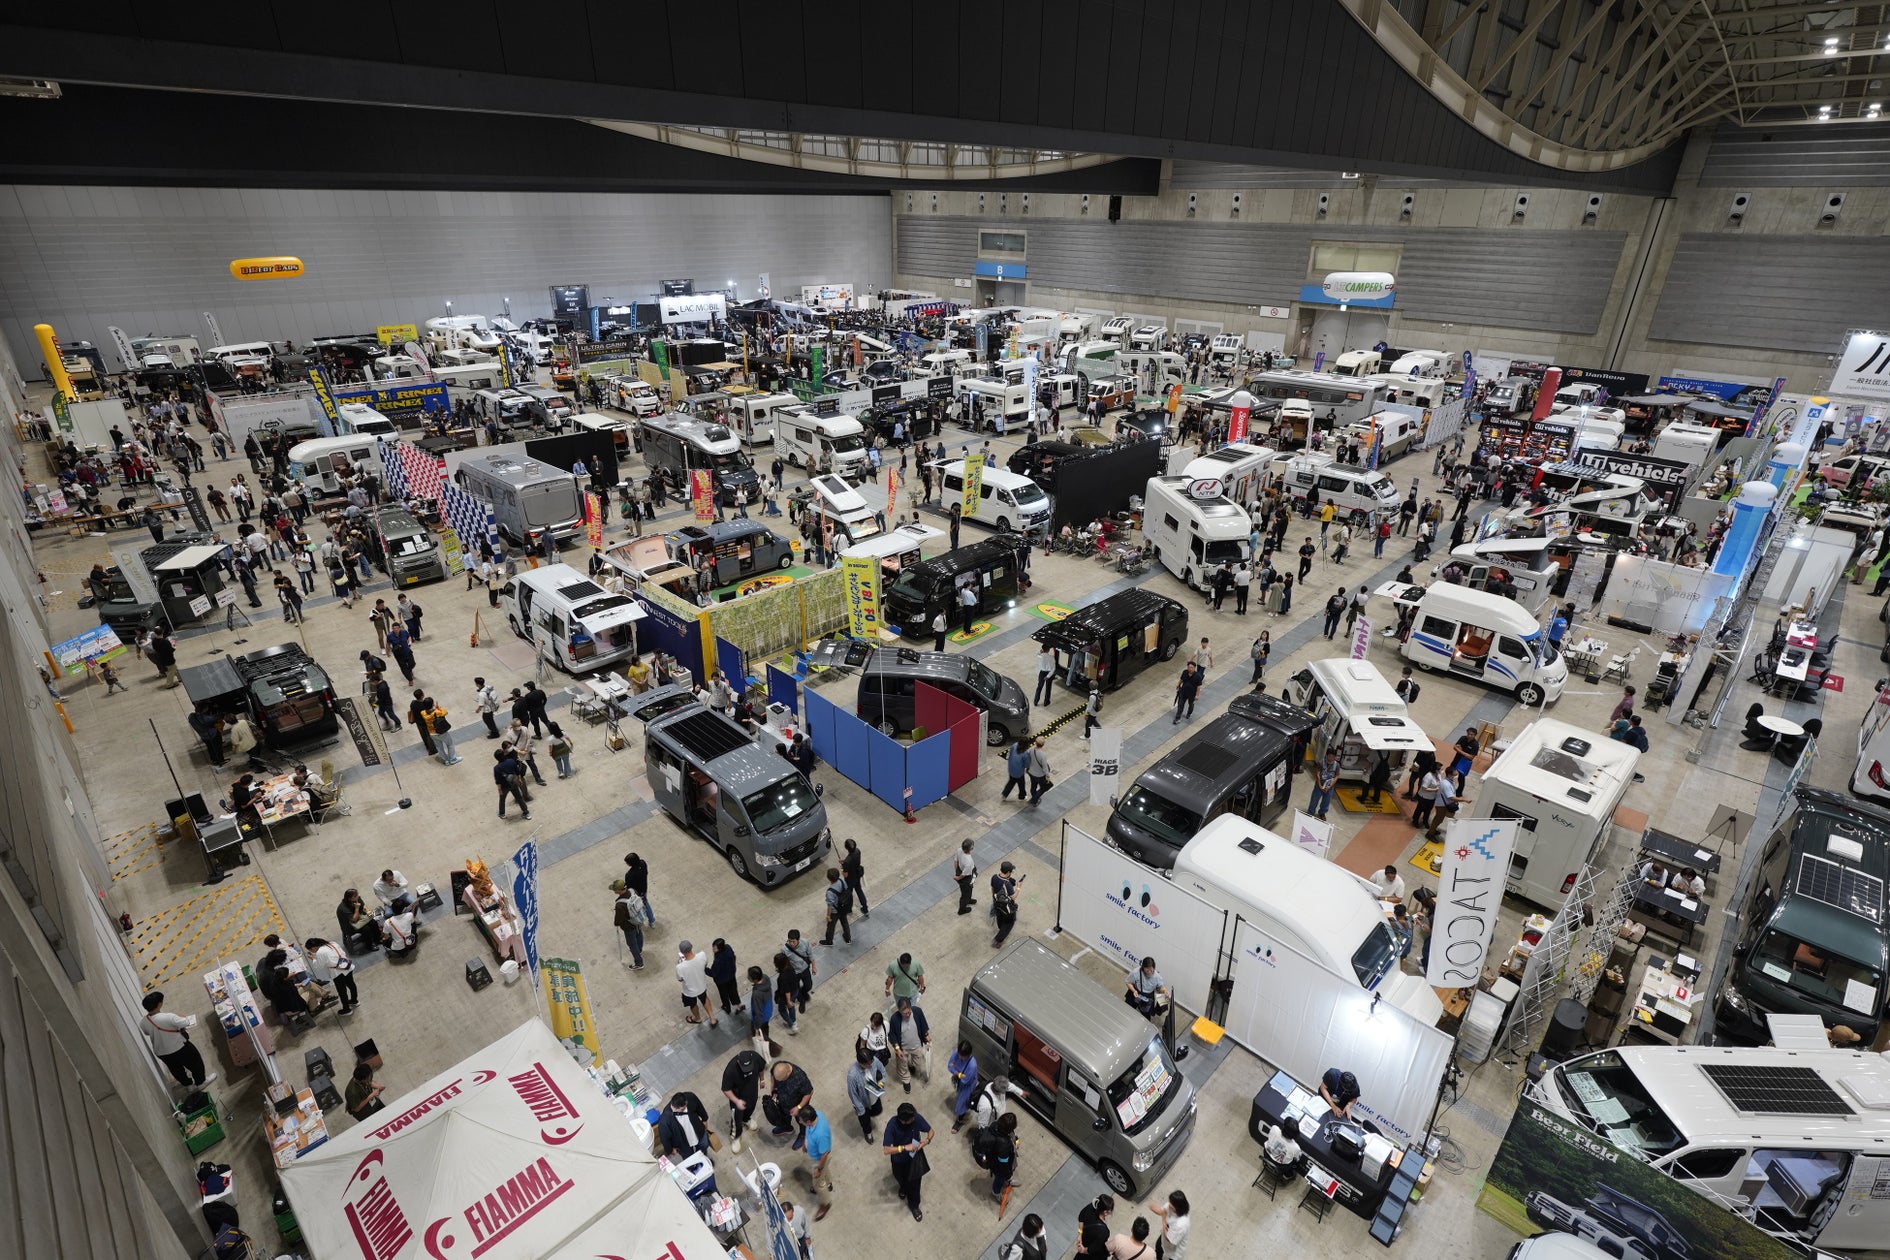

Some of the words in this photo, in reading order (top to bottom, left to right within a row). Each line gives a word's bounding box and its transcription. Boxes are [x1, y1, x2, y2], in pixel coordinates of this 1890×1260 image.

[1092, 764, 1118, 776] 3B
[1106, 893, 1126, 909] smile
[1127, 906, 1160, 929] factory
[1100, 934, 1122, 952] smile
[374, 1085, 463, 1140] FIAMMA
[508, 1070, 568, 1122] FIAMMA
[1356, 1101, 1375, 1115] mile
[1376, 1114, 1412, 1138] factory
[1531, 1109, 1572, 1135] Bear
[1573, 1132, 1619, 1163] Field
[463, 1156, 562, 1244] FIAMMA
